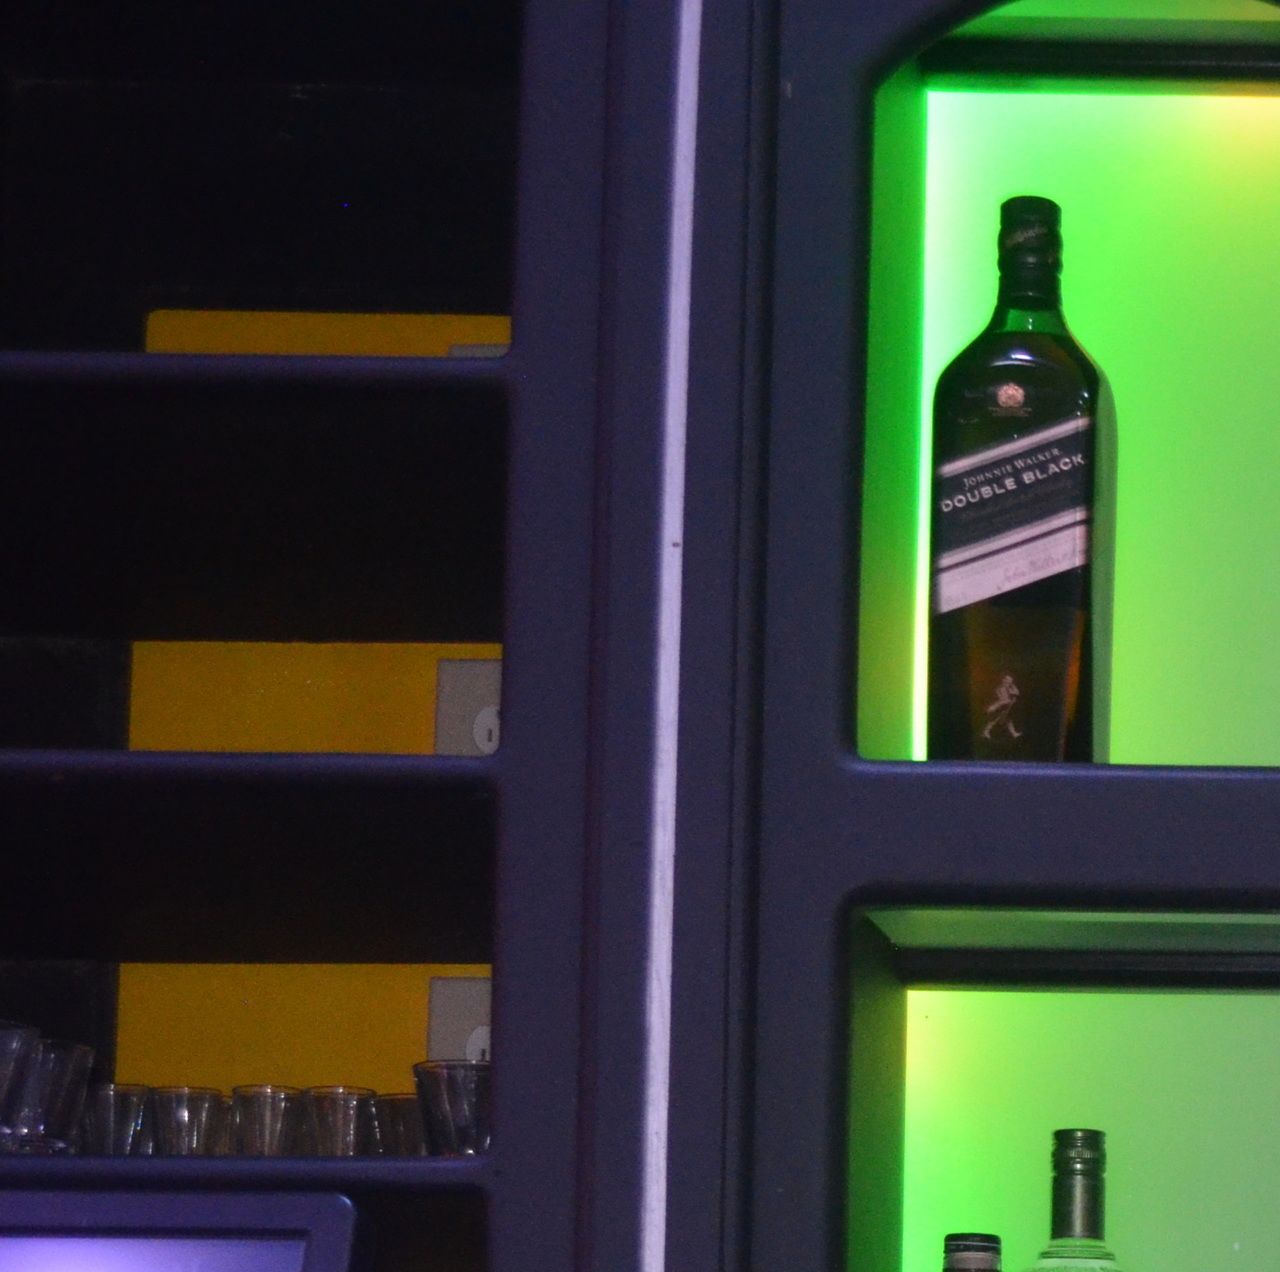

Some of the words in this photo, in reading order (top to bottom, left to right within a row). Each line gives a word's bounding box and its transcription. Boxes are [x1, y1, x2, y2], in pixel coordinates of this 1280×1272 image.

[941, 477, 1017, 512] DOUBLE
[1023, 453, 1086, 485] BLACK
[963, 461, 1014, 489] JOHNNIE
